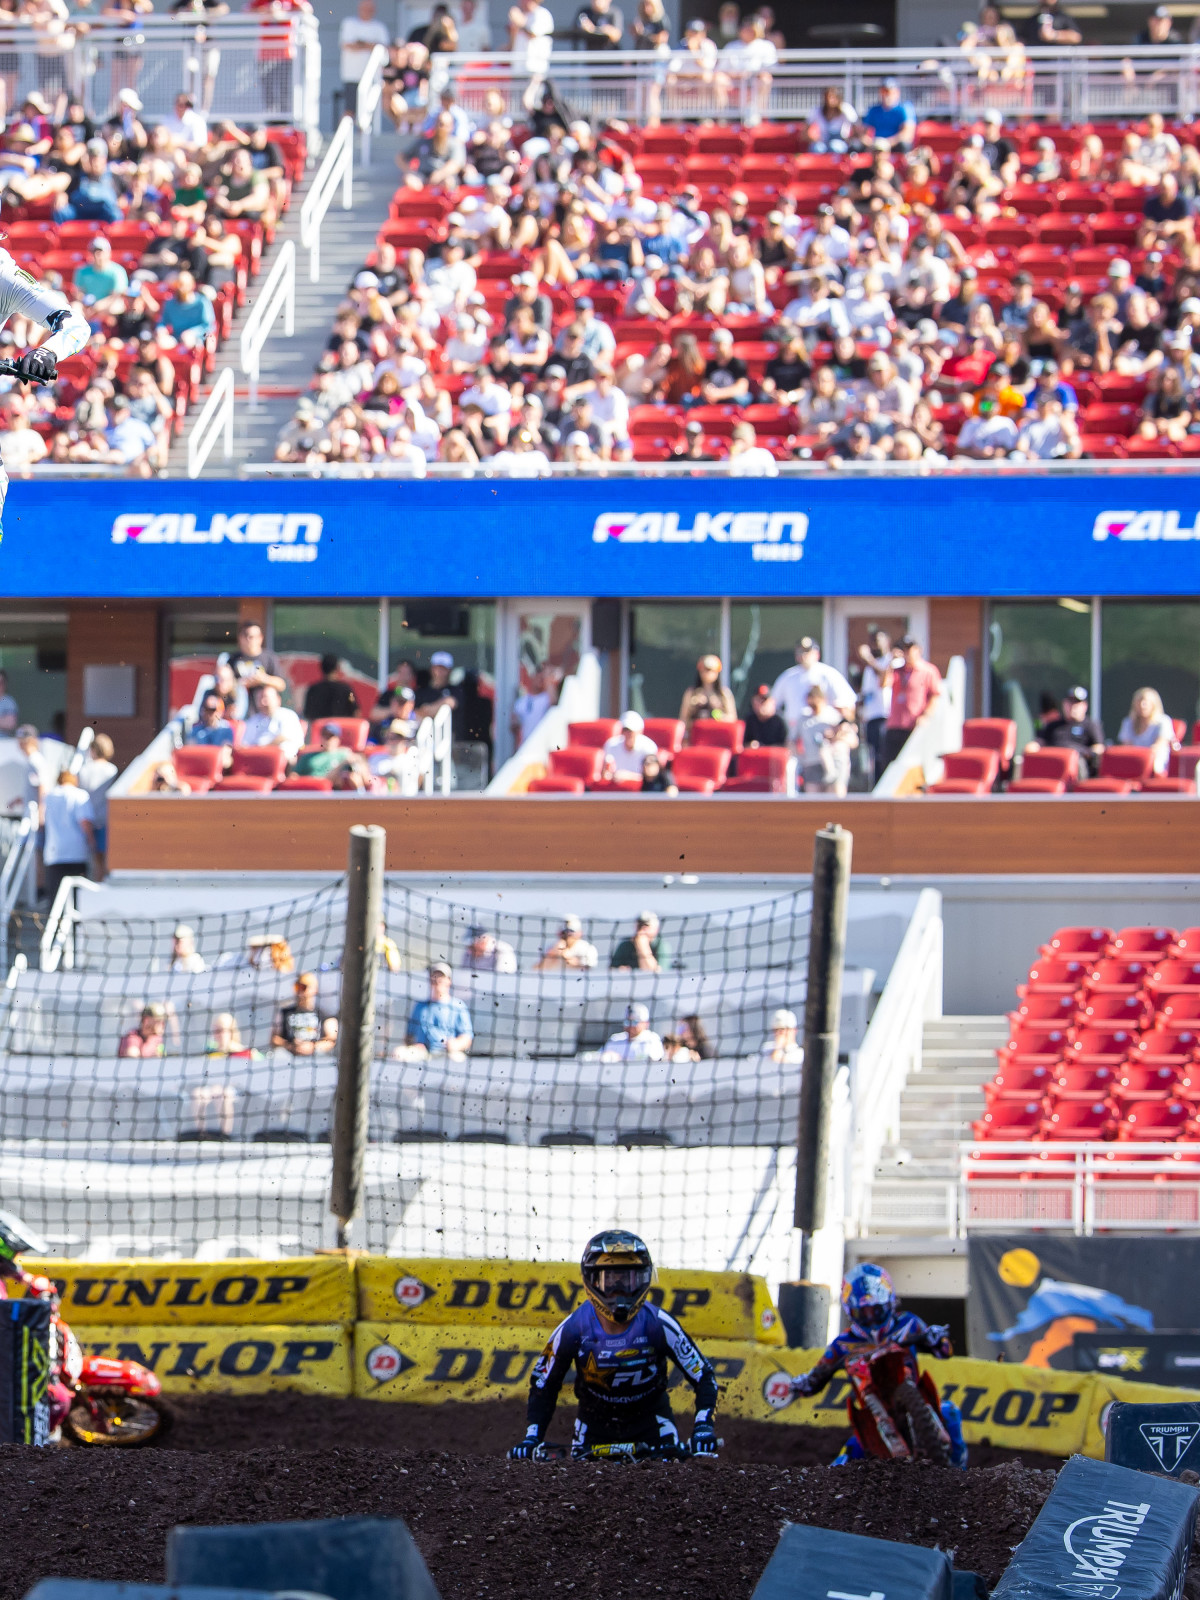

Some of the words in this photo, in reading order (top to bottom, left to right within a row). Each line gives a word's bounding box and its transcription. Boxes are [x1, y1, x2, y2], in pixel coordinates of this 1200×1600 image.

[111, 513, 323, 544] FALKEN
[592, 511, 809, 543] FALKEN
[1092, 510, 1200, 541] FAL
[446, 1279, 711, 1317] DUNP
[82, 1341, 334, 1376] NLOP
[813, 1378, 1081, 1428] DLOP
[1064, 1500, 1152, 1581] TRIUMPH
